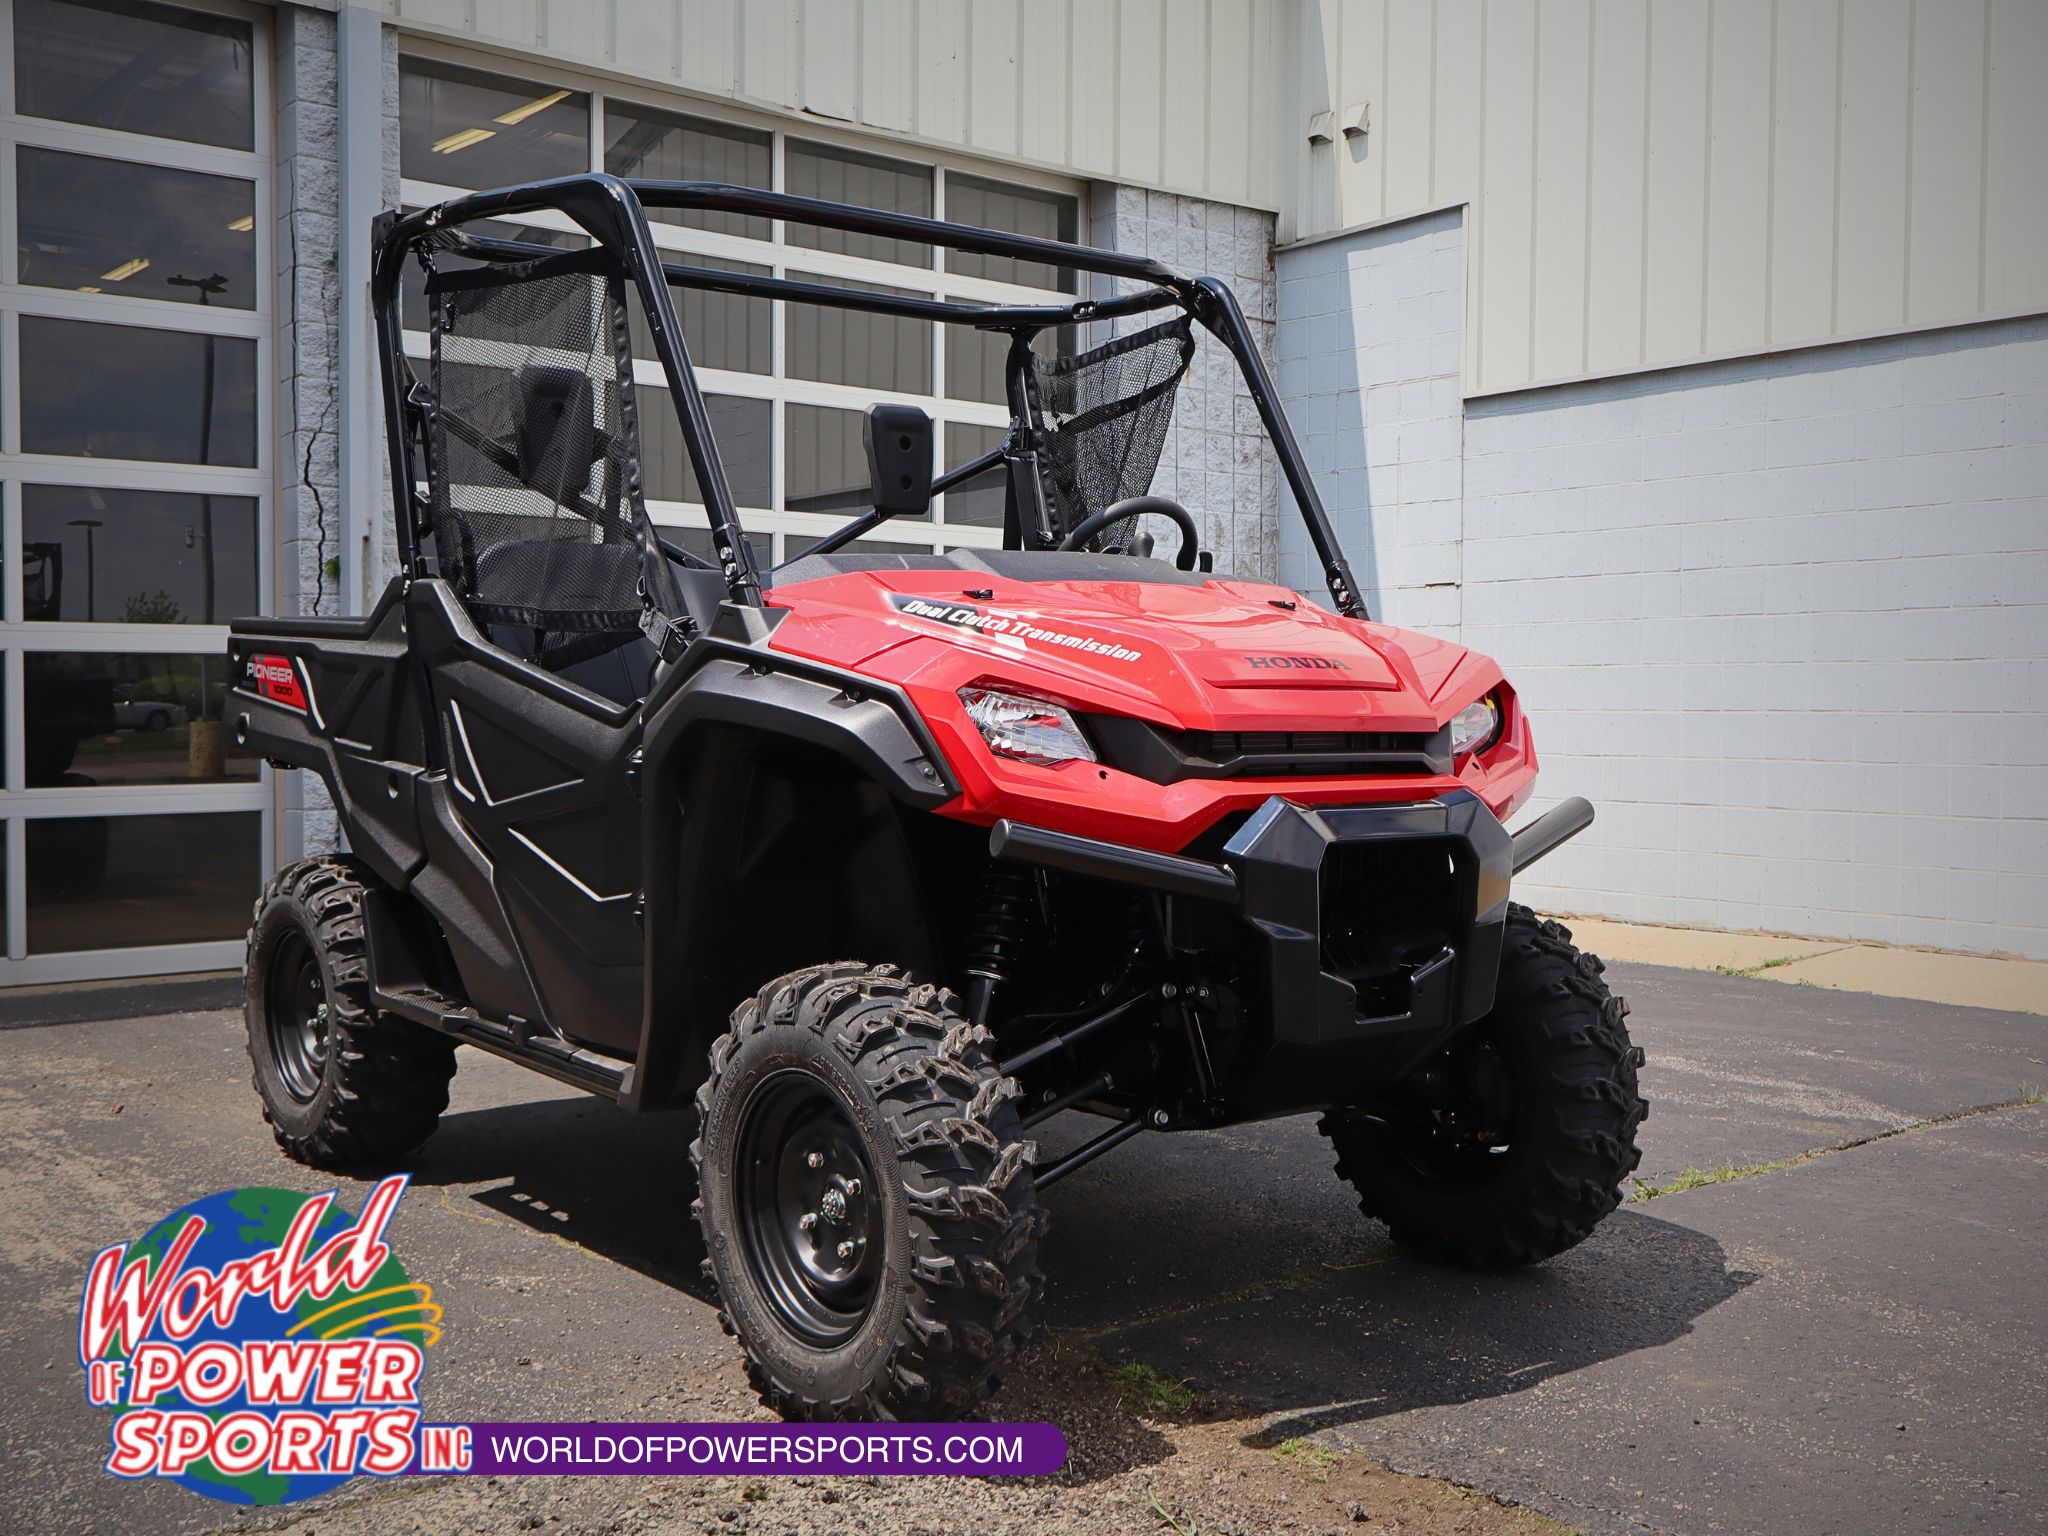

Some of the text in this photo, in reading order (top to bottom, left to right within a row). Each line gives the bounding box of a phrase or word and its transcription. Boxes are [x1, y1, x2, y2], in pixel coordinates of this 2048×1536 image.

[902, 600, 1142, 663] Dual Clutch Transmission
[1244, 656, 1352, 670] HONDA
[246, 662, 293, 684] PIONEER
[273, 684, 293, 697] 1000
